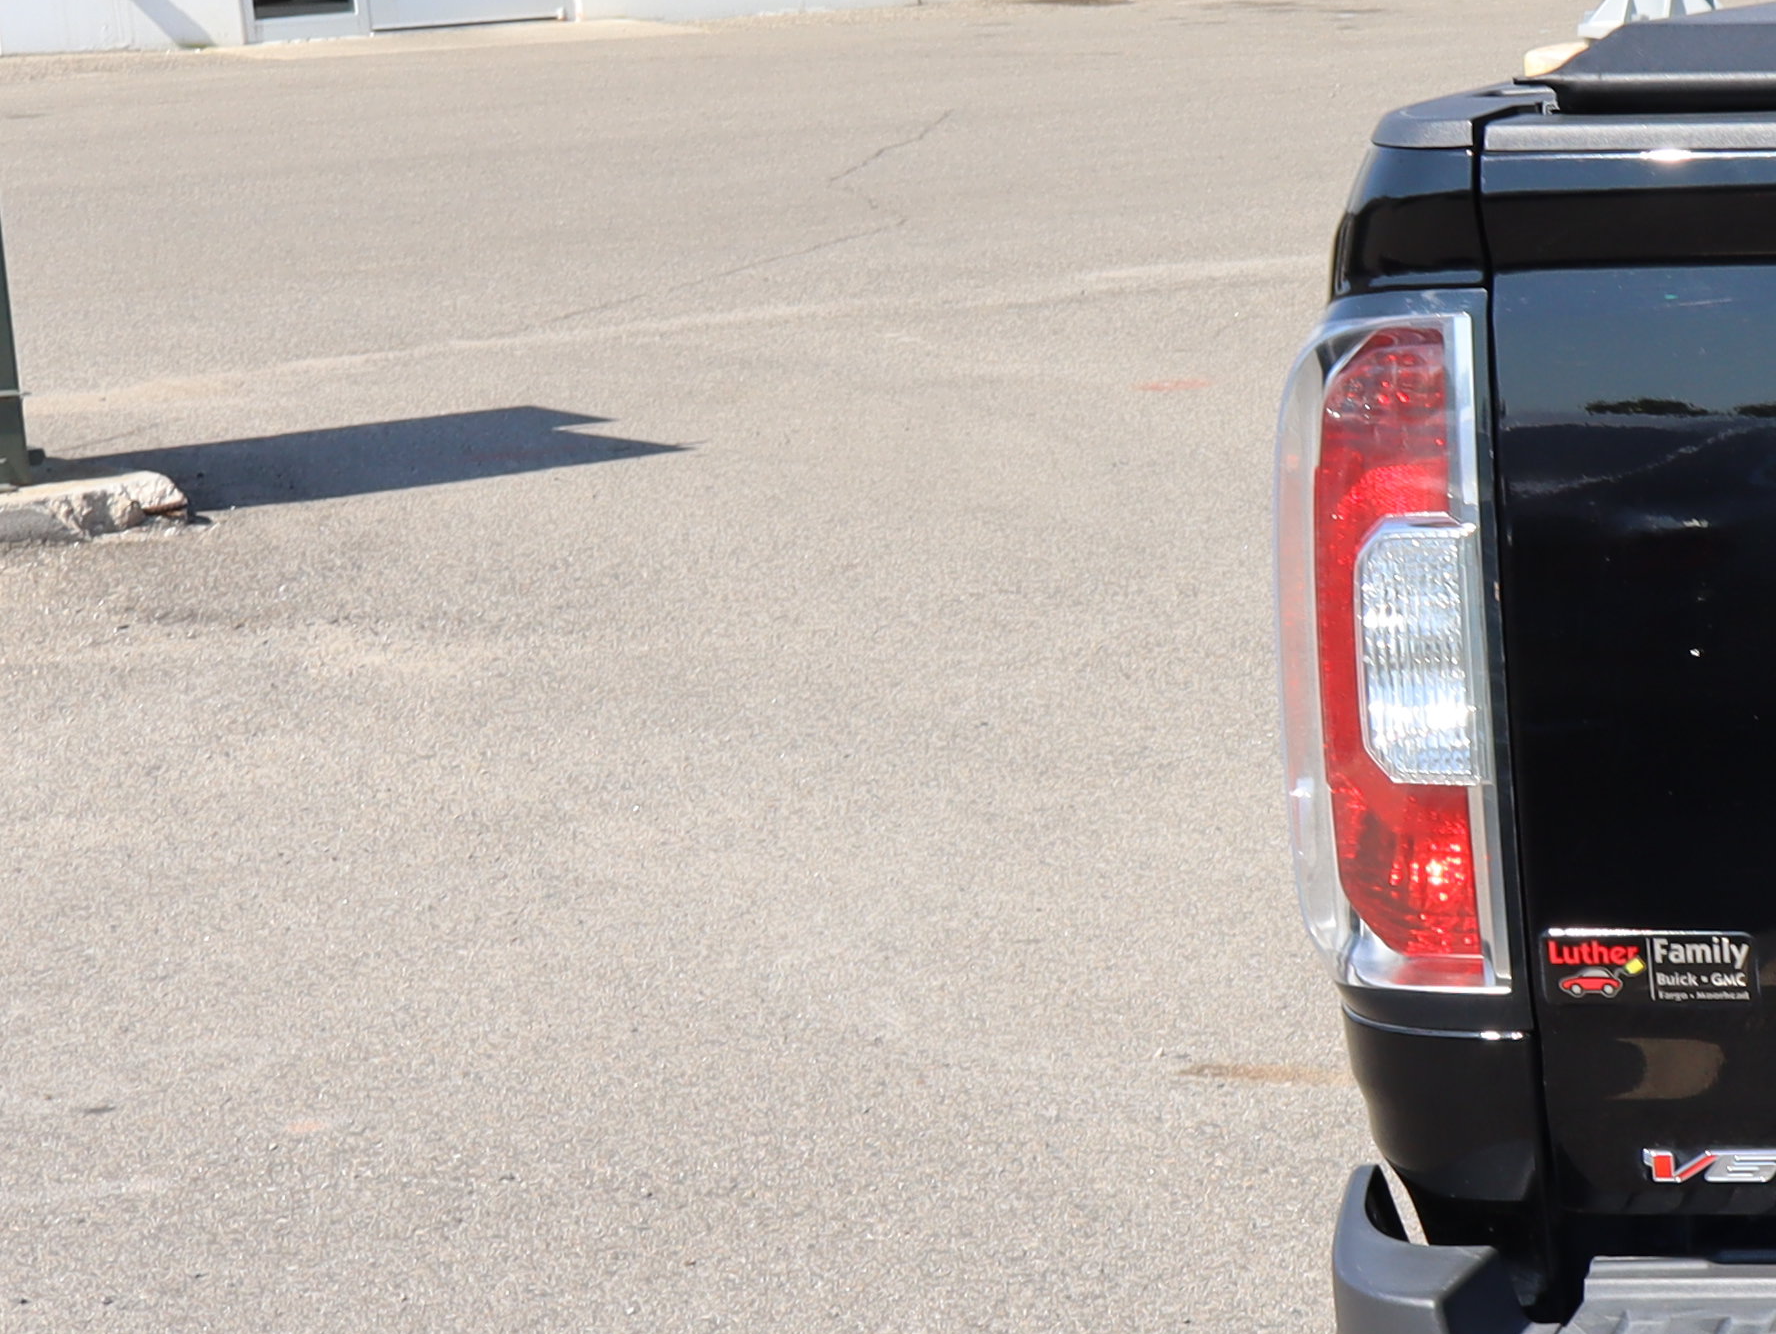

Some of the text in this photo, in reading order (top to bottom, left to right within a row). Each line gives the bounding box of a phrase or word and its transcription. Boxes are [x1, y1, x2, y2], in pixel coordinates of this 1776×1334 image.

[1547, 940, 1640, 966] Luther
[1653, 936, 1750, 970] Family
[1656, 971, 1747, 987] Buick GMC
[1658, 990, 1689, 1002] Fargo
